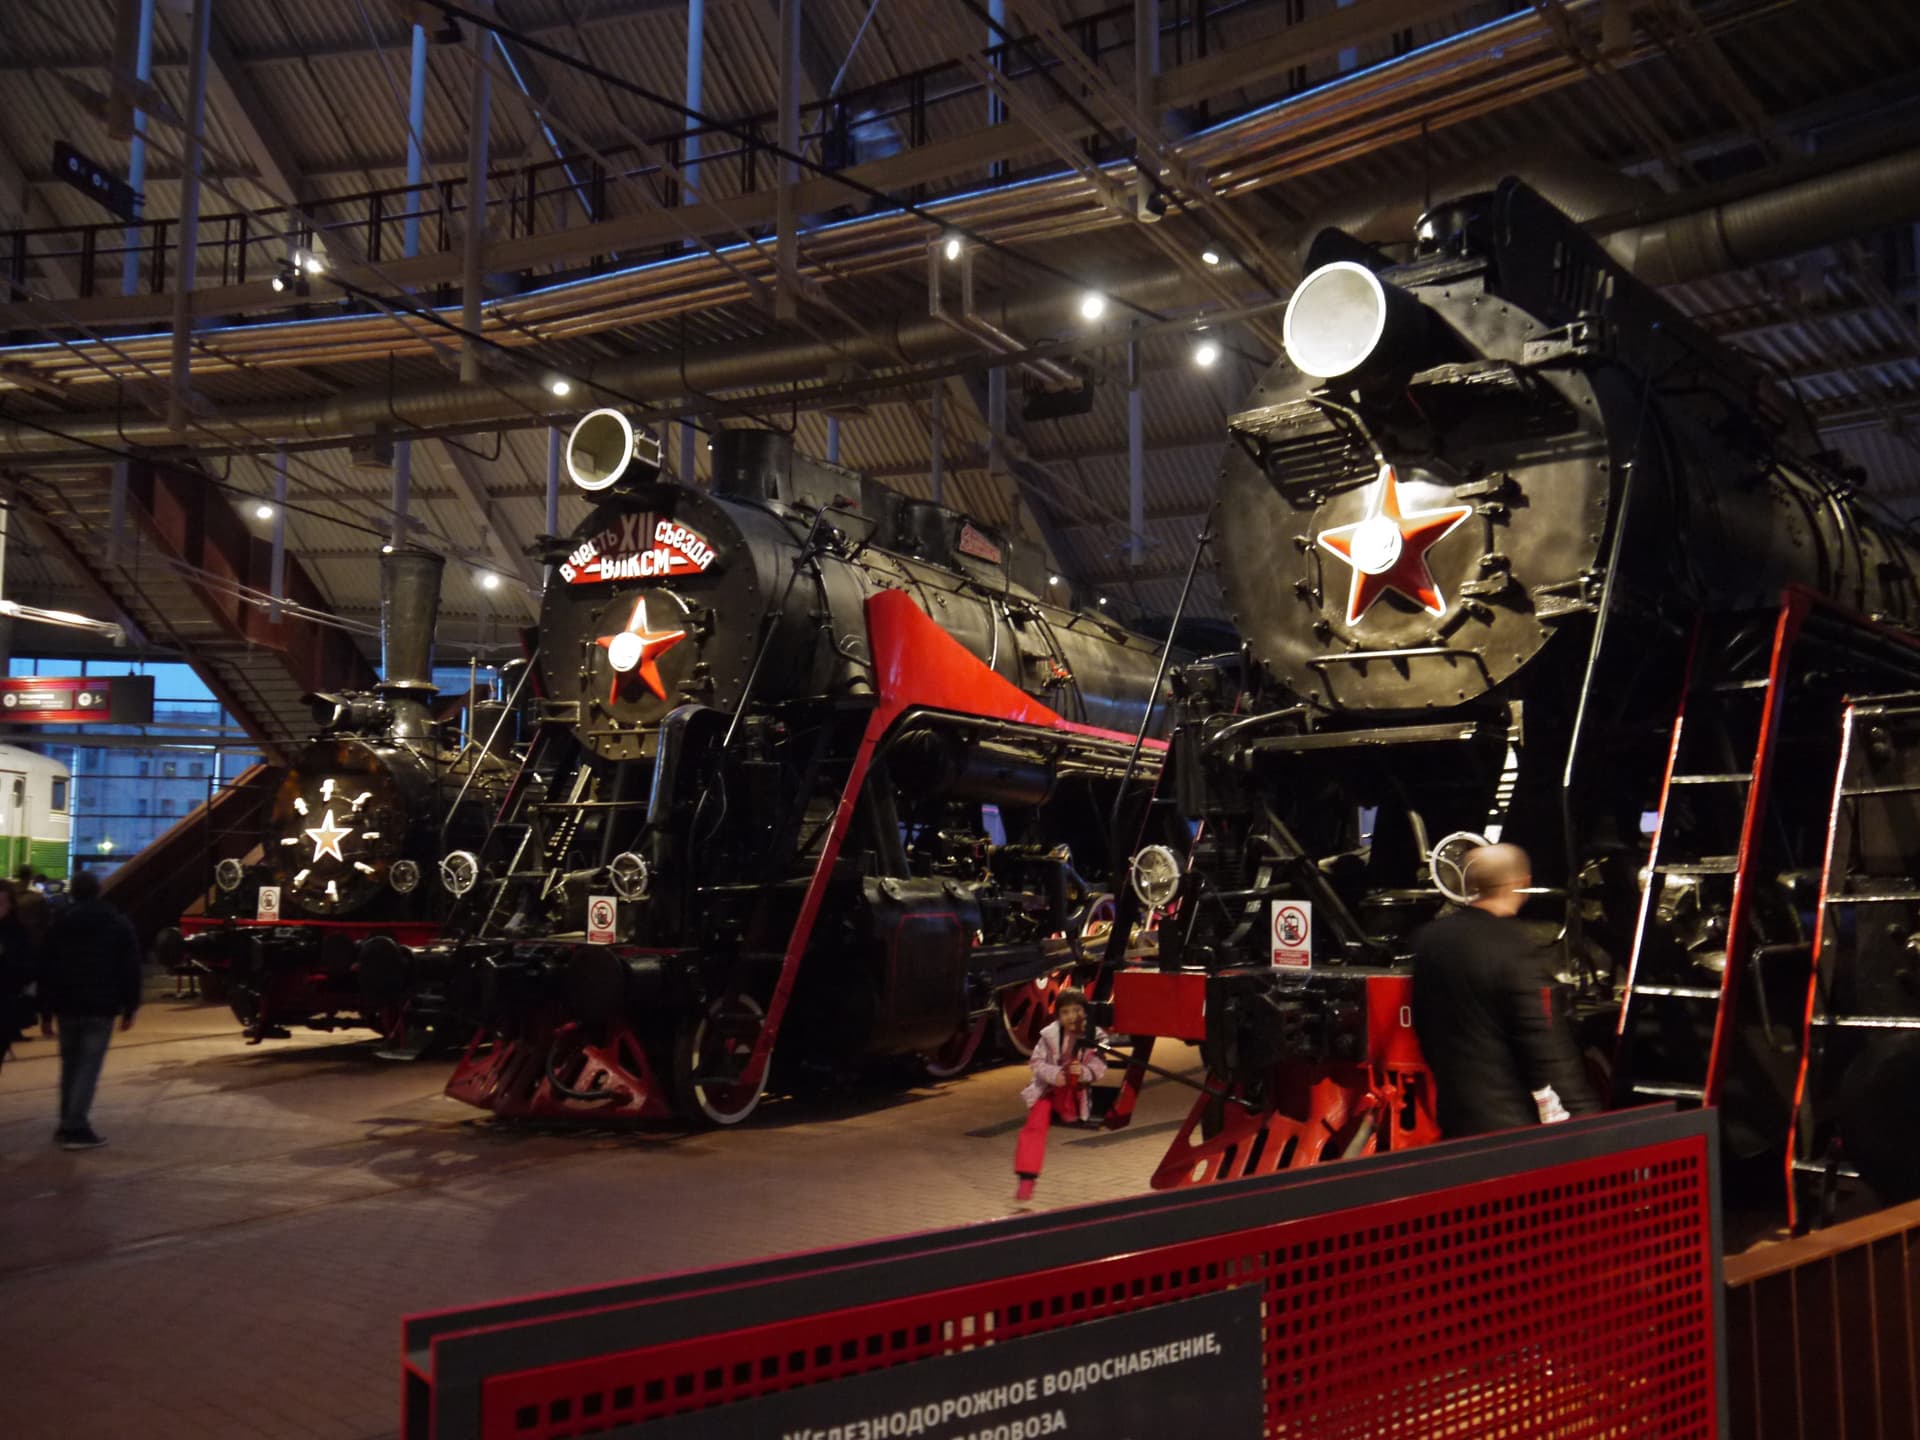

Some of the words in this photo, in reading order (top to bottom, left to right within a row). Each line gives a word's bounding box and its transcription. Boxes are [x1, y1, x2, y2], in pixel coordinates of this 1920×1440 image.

[600, 548, 671, 580] ВЛКСМ
[1042, 1331, 1222, 1397] ВОДОСНАБЖЕНИЕ,
[950, 1408, 1067, 1440] ОВОЗА
